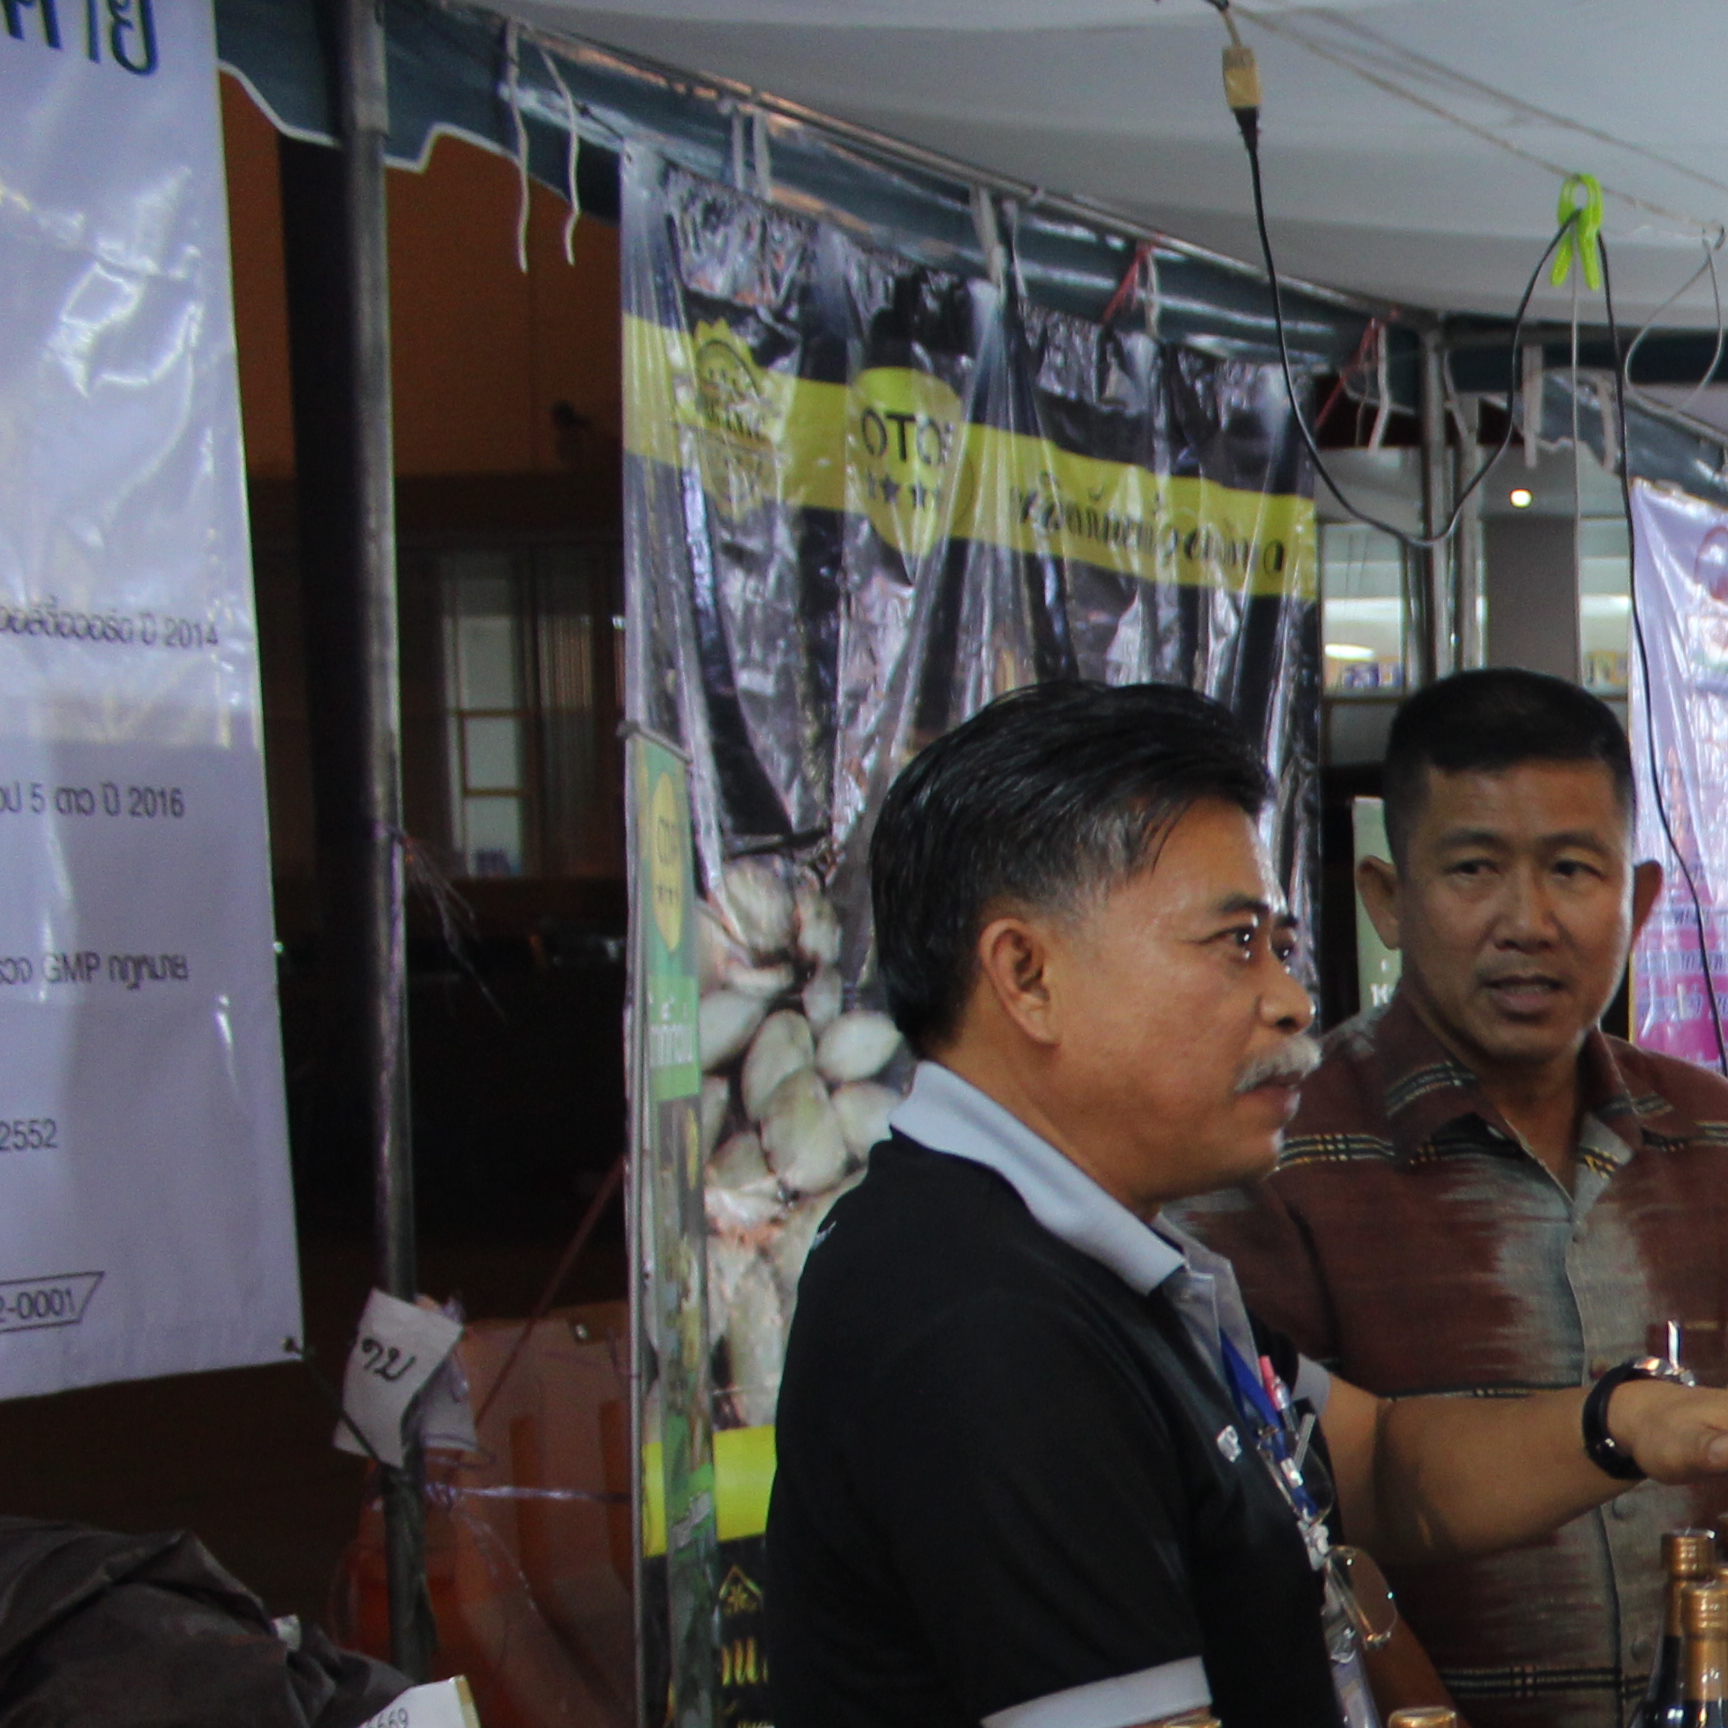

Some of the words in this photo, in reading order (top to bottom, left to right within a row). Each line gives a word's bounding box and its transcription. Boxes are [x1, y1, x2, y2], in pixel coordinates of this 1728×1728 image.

[163, 615, 219, 647] 2014
[30, 781, 45, 814] 5
[127, 786, 185, 818] 2016
[44, 953, 100, 984] GMP
